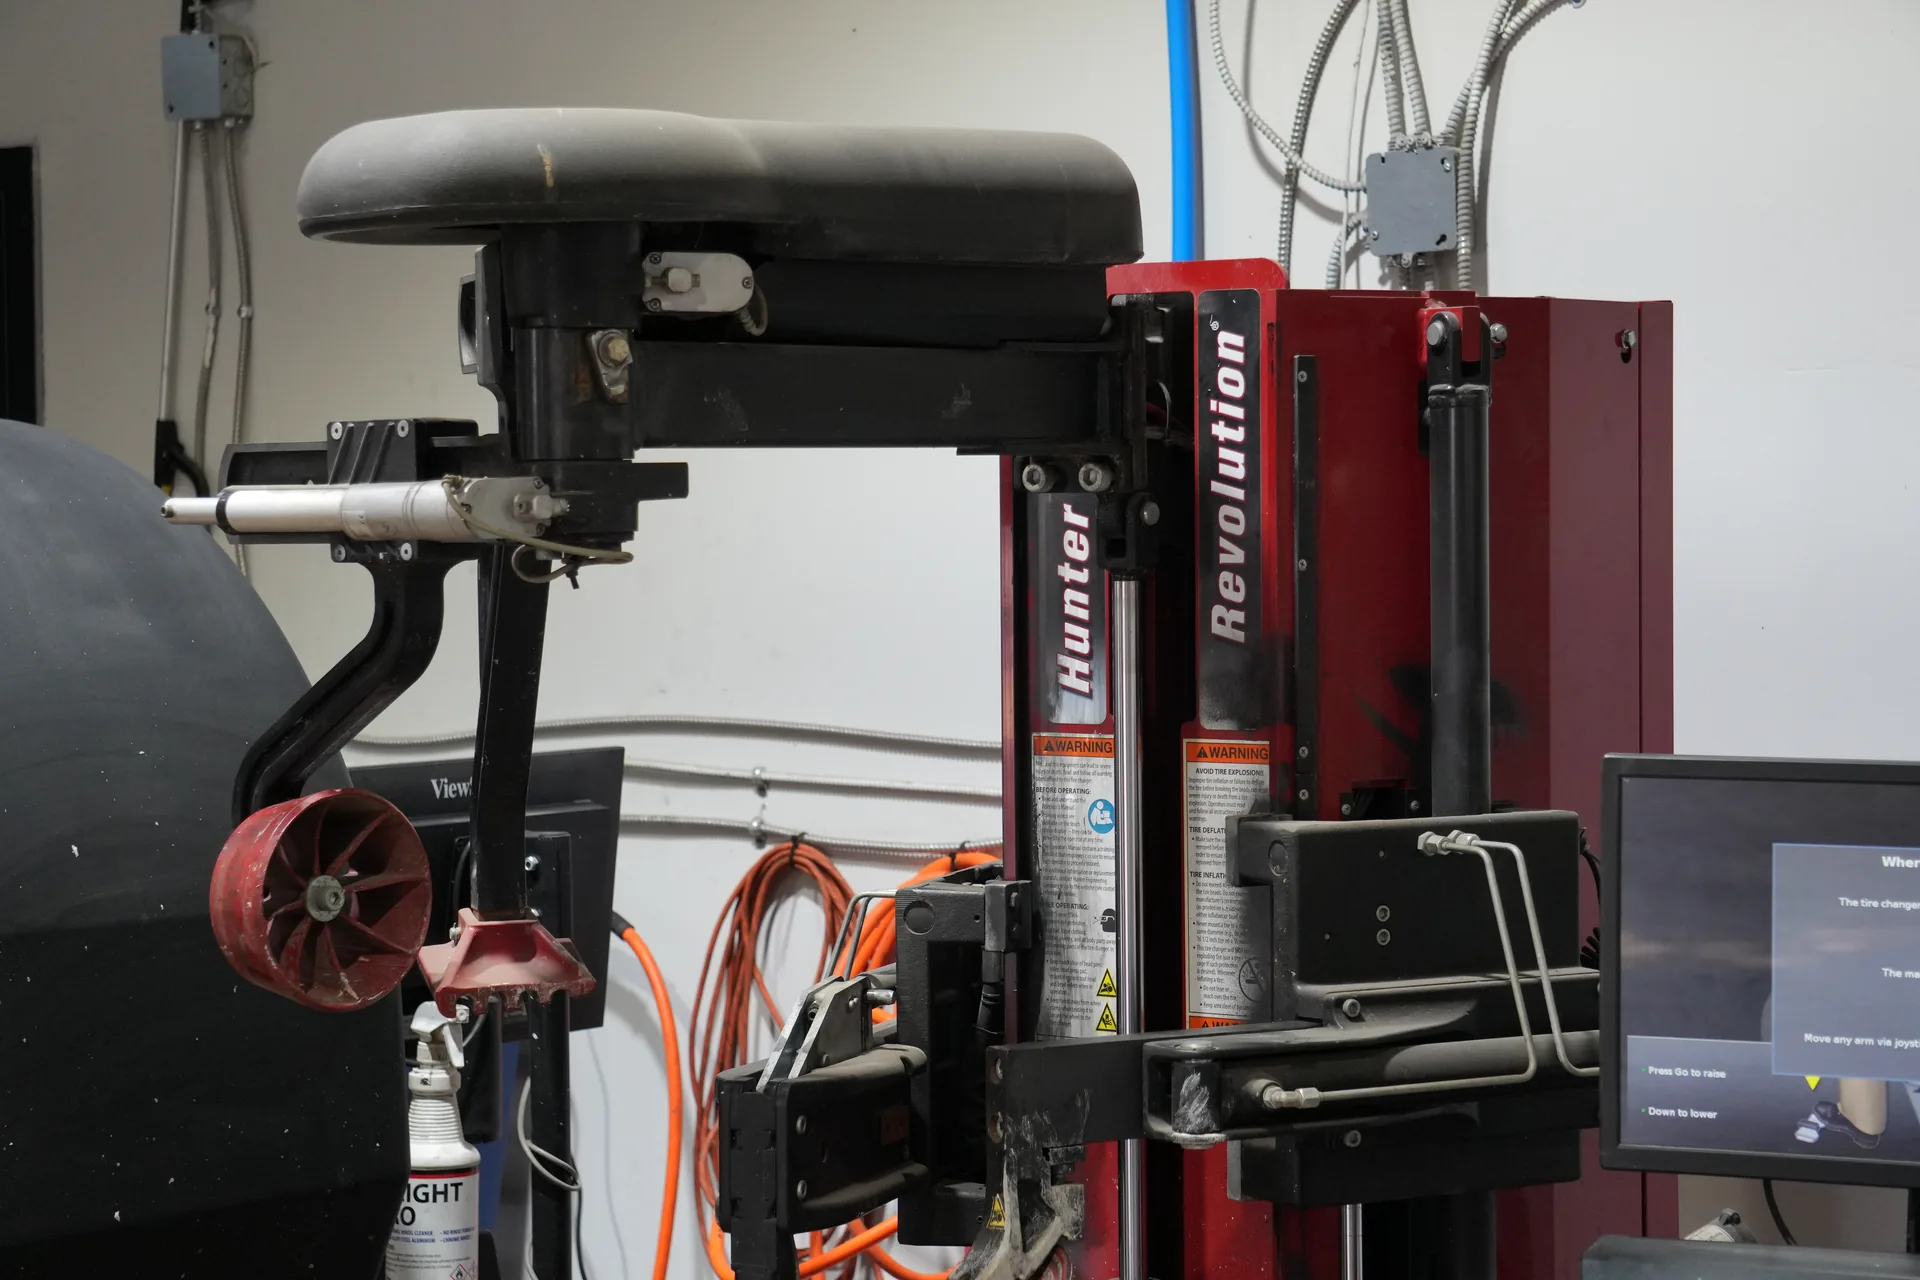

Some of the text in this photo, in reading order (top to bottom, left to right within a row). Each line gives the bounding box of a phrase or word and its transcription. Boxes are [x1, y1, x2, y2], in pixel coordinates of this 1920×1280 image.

[1210, 329, 1246, 644] Revolution
[1056, 502, 1092, 698] Hunter
[1056, 740, 1112, 754] WARNING
[1209, 746, 1268, 760] WARNING
[430, 776, 472, 800] View
[1036, 786, 1056, 794] BEFORE
[1056, 902, 1089, 910] OPERATING:
[1838, 897, 1859, 907] The
[1860, 898, 1879, 908] tire
[1881, 967, 1902, 978] The
[1804, 1033, 1831, 1043] Move
[1833, 1036, 1852, 1046] any
[1854, 1037, 1874, 1046] arm
[1877, 1038, 1892, 1046] via
[1648, 1066, 1726, 1078] Press Go to raise
[1648, 1106, 1718, 1119] Down to lower
[403, 1182, 463, 1204] IGHT
[396, 1206, 416, 1226] O
